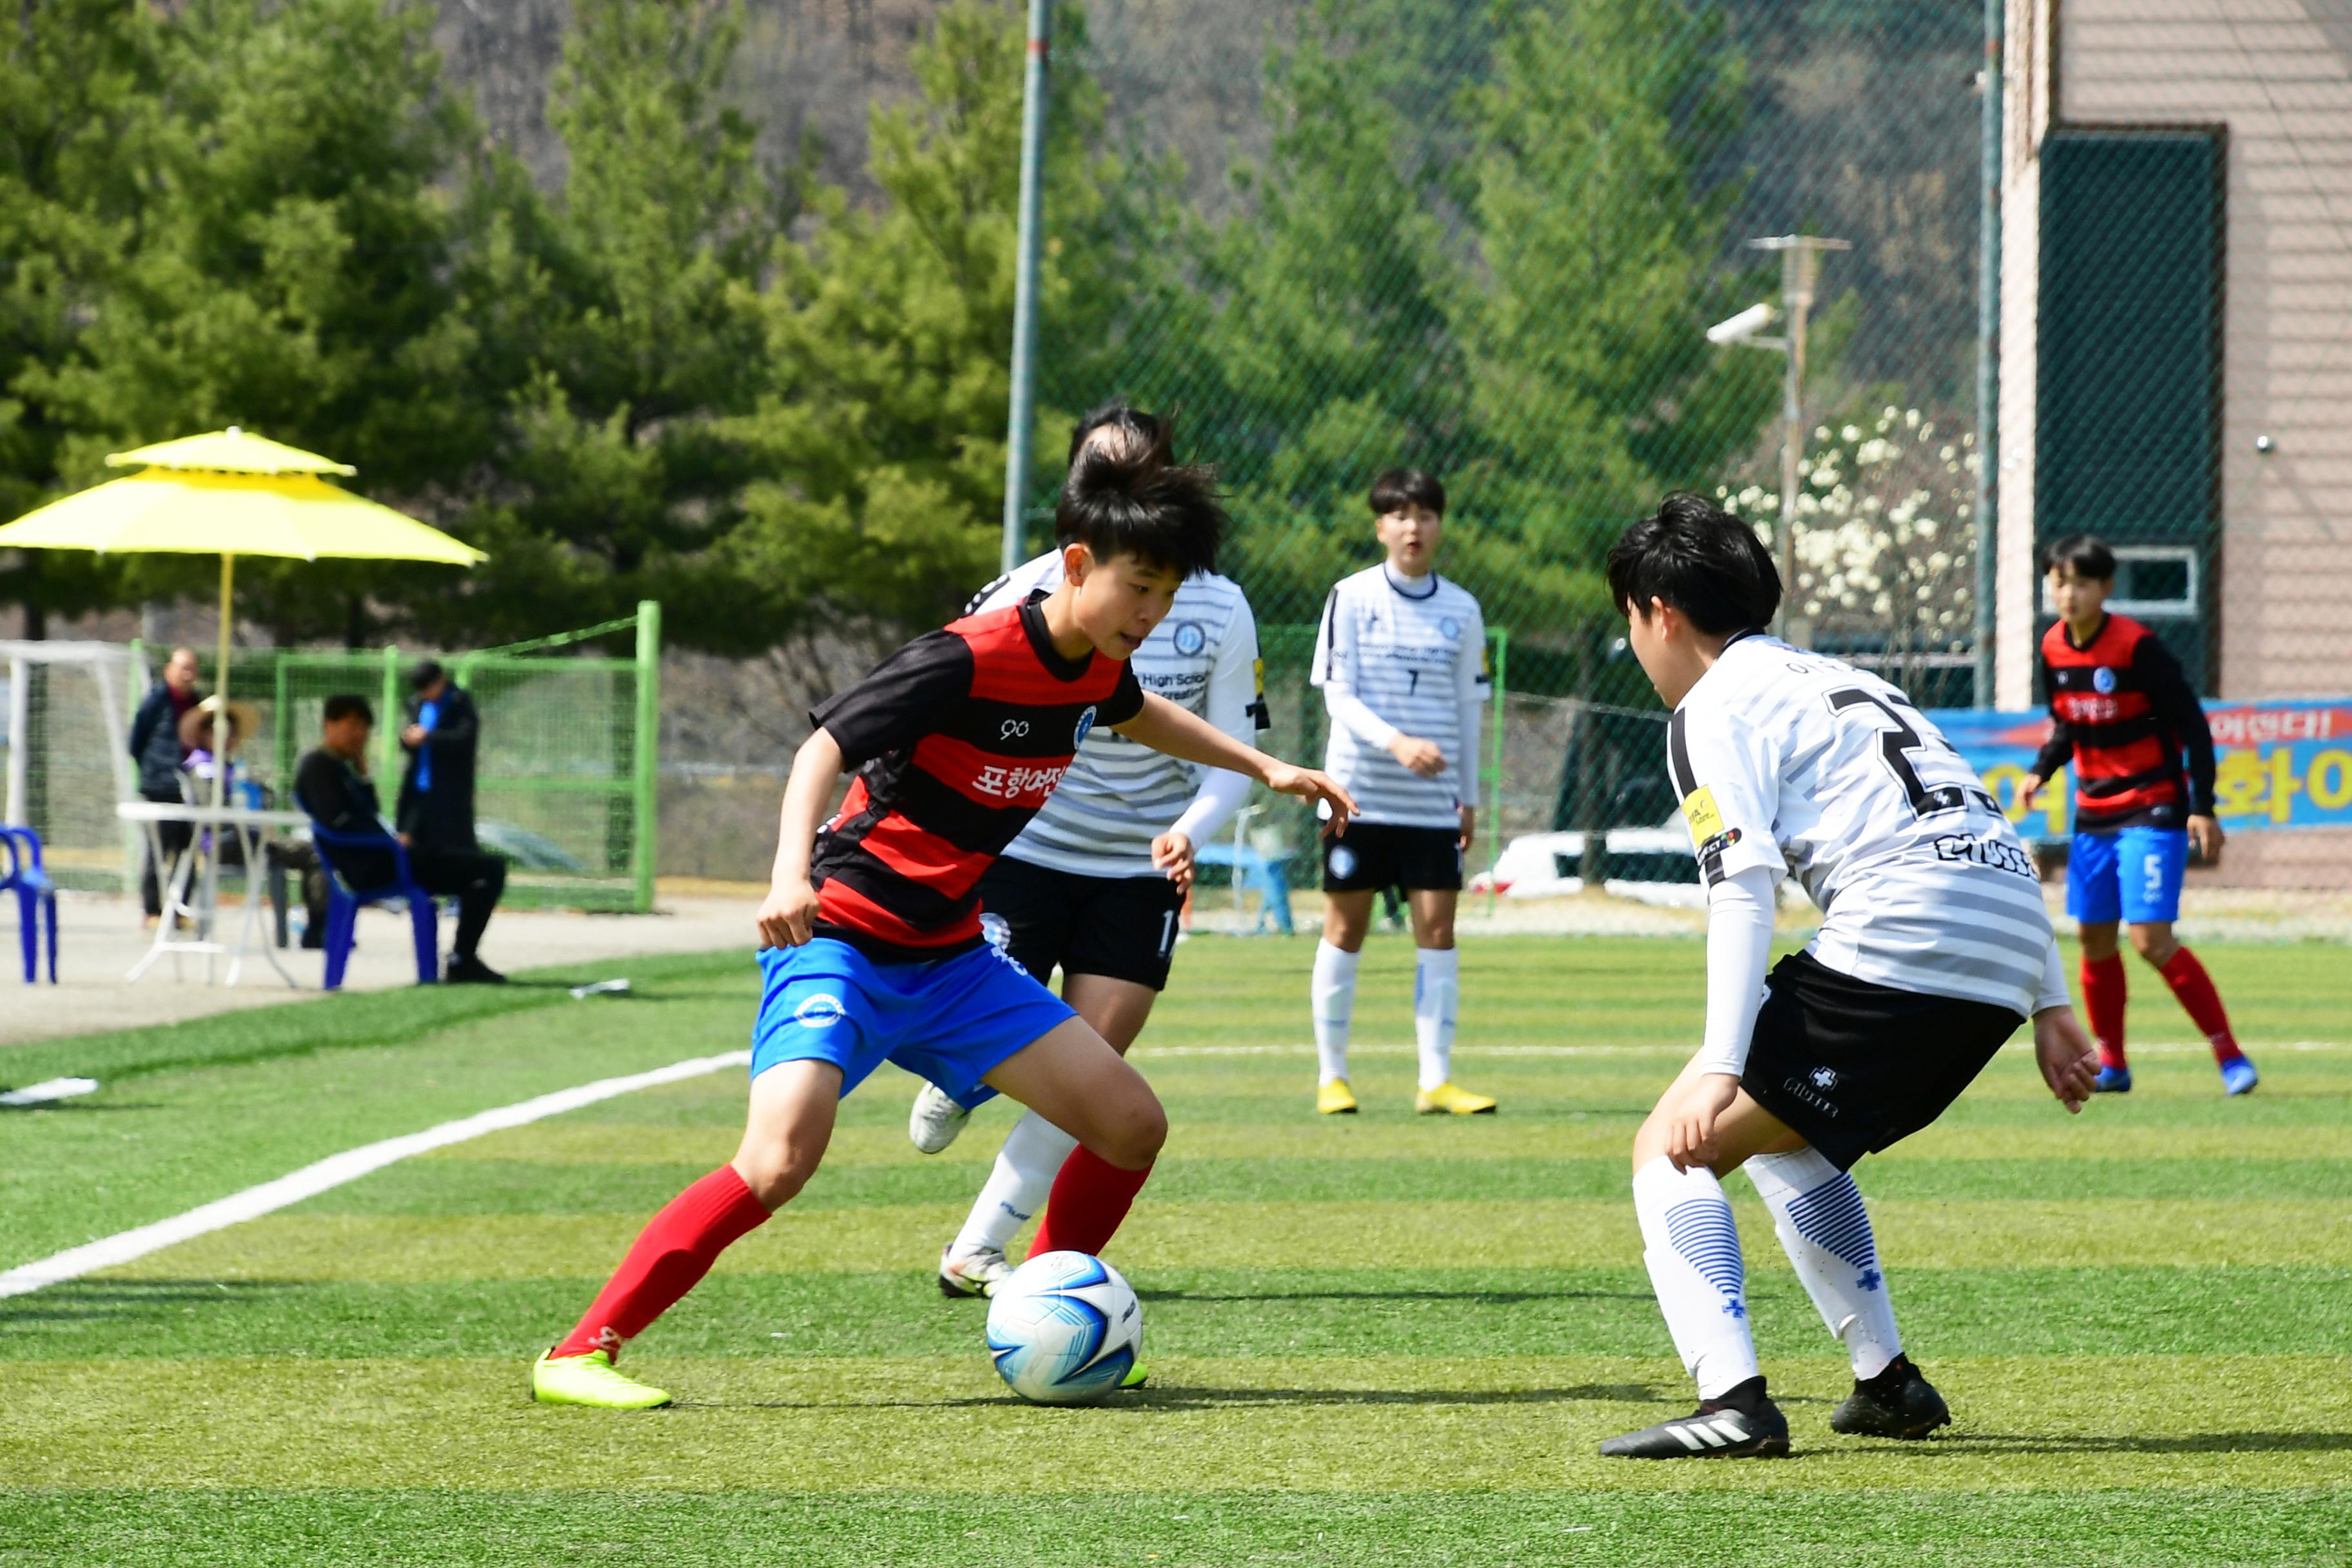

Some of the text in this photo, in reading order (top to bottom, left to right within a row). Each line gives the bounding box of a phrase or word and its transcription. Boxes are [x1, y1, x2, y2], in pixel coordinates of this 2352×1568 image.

[1142, 673, 1173, 687] High
[1408, 670, 1418, 696] 7
[2143, 854, 2162, 888] 5
[1159, 909, 1175, 952] 1
